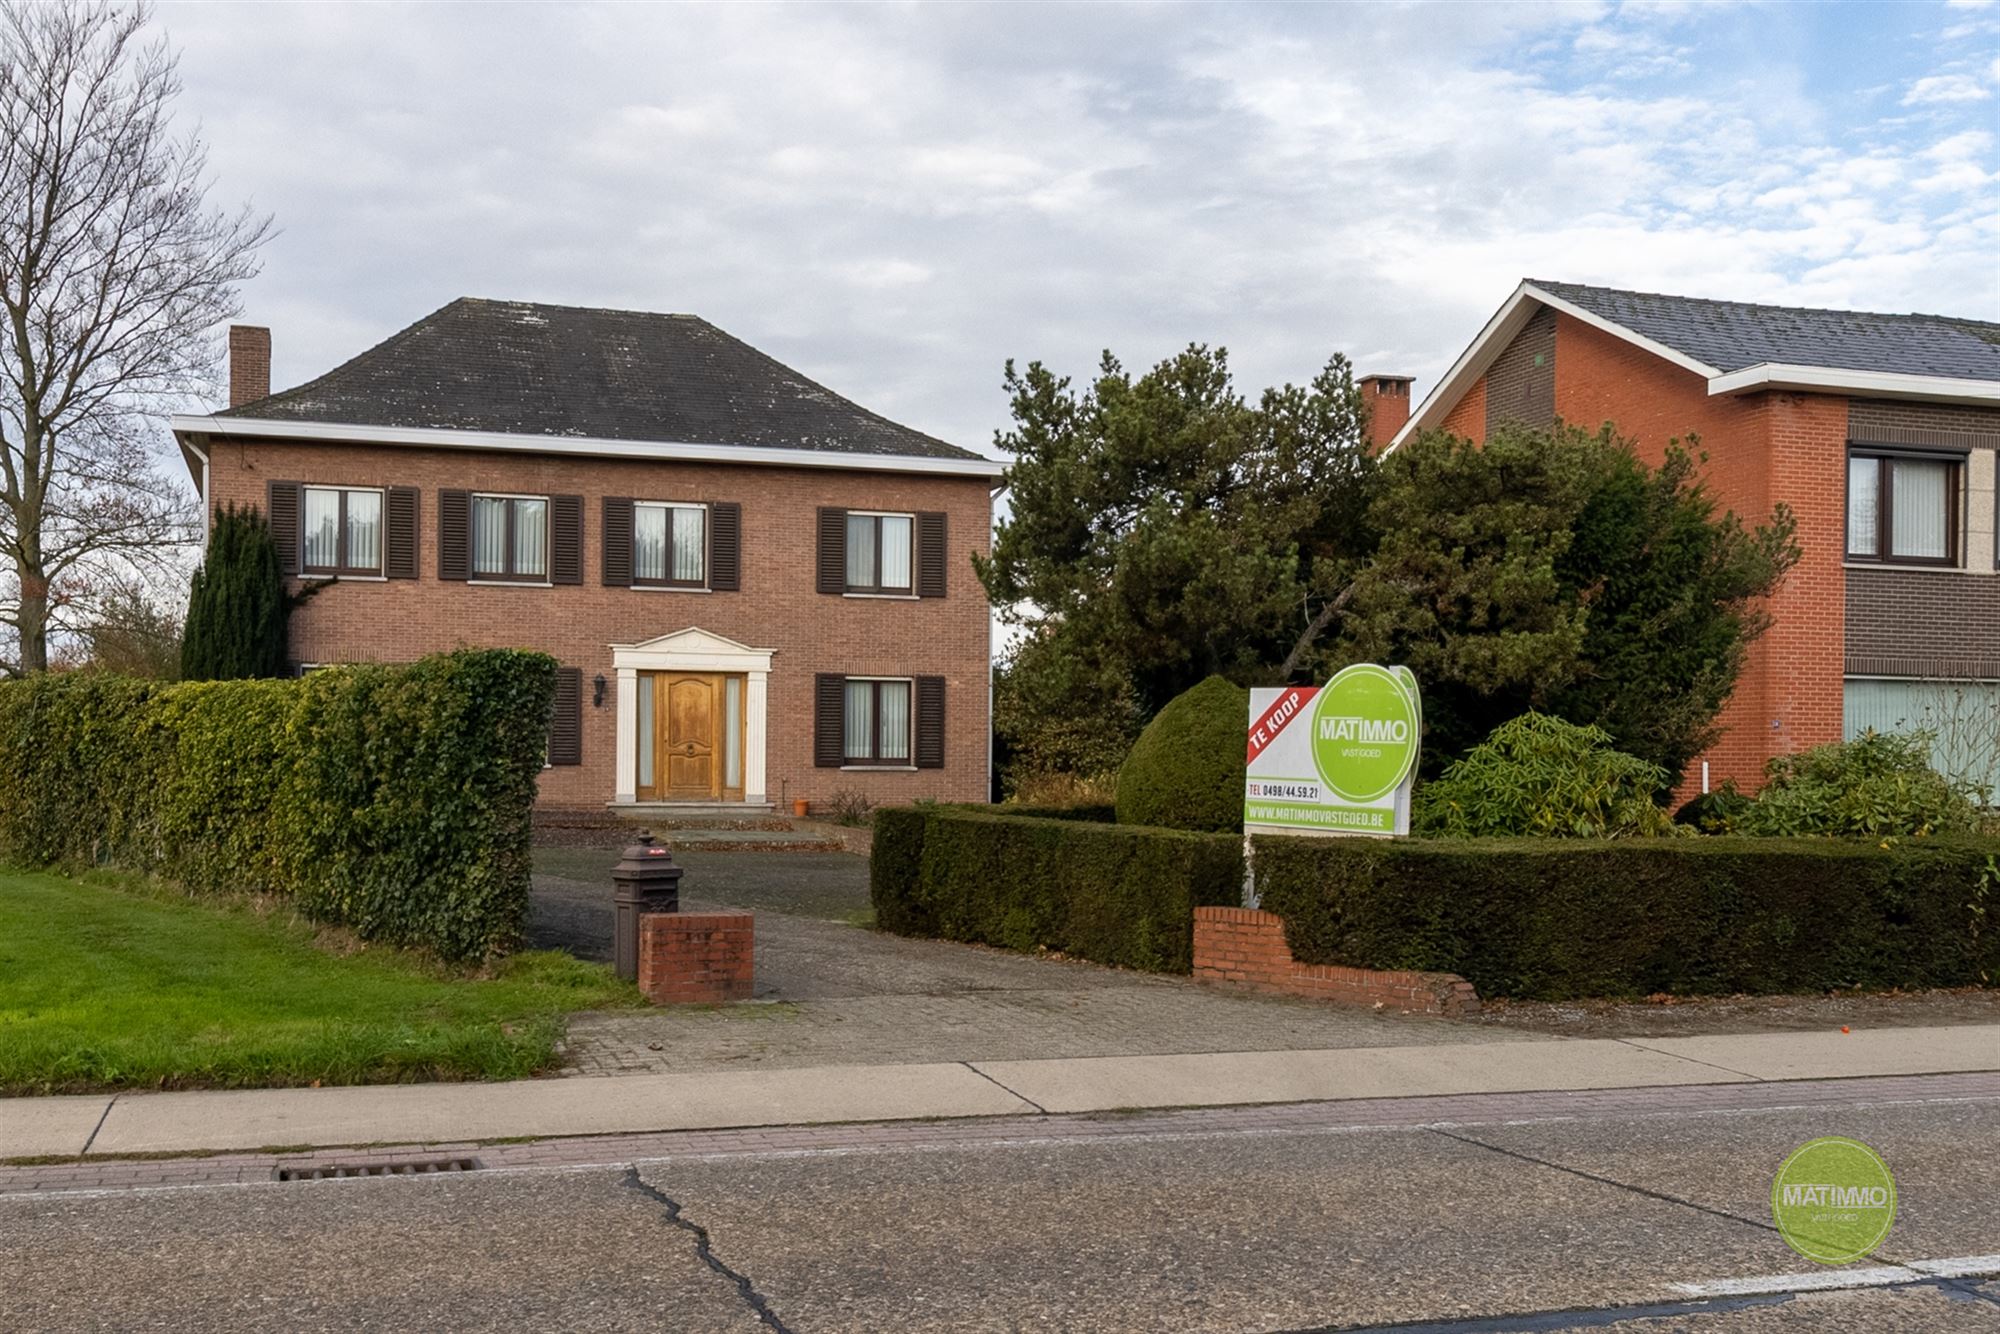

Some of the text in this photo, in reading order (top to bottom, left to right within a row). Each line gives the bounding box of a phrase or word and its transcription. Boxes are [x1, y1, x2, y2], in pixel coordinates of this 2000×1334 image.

[1250, 692, 1299, 750] TE KOOP
[1320, 718, 1408, 742] MATIMMO
[1249, 784, 1318, 799] TEL 0498/44.59.21
[1249, 805, 1384, 827] WWW.MATIMMOVASTGOED.BE
